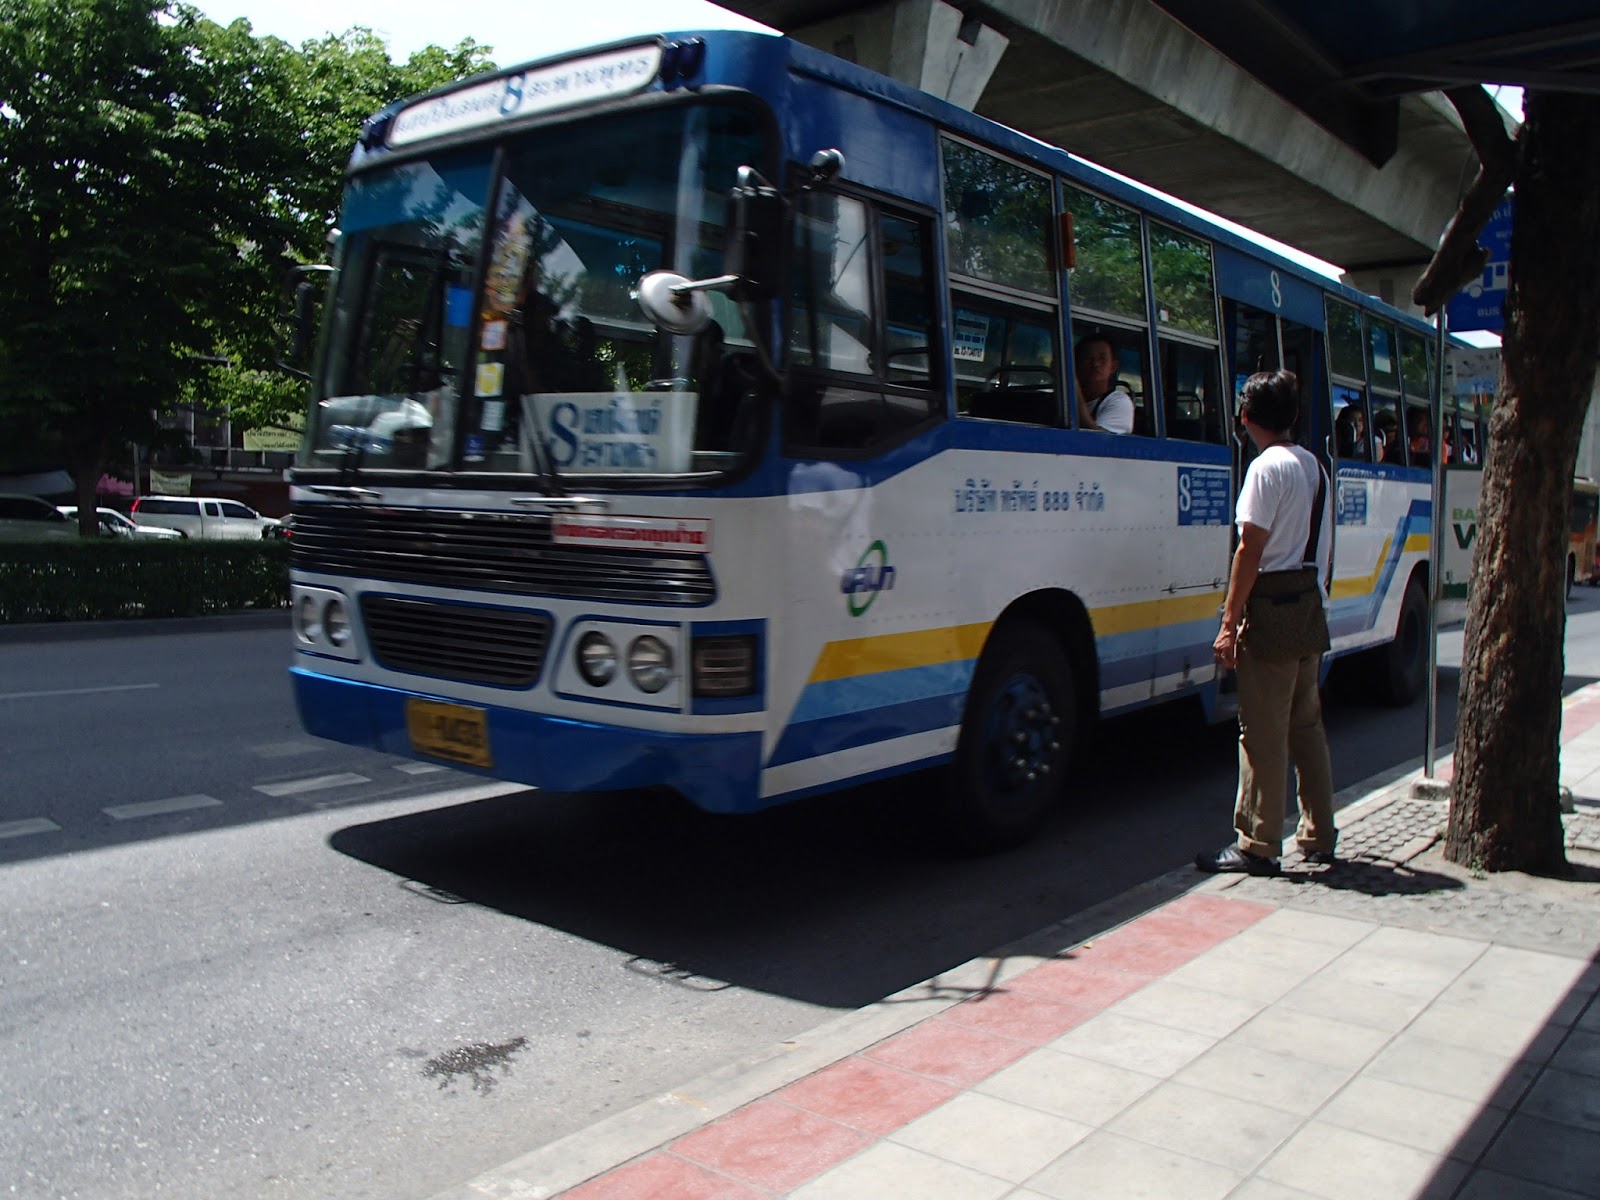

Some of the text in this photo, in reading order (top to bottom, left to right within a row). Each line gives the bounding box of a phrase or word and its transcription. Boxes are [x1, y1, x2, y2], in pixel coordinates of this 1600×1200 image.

[500, 73, 525, 115] 8
[1270, 271, 1282, 308] 8
[550, 402, 579, 467] 8
[1043, 490, 1071, 512] 888
[1075, 481, 1106, 512] จำกัด
[1179, 474, 1192, 512] 8
